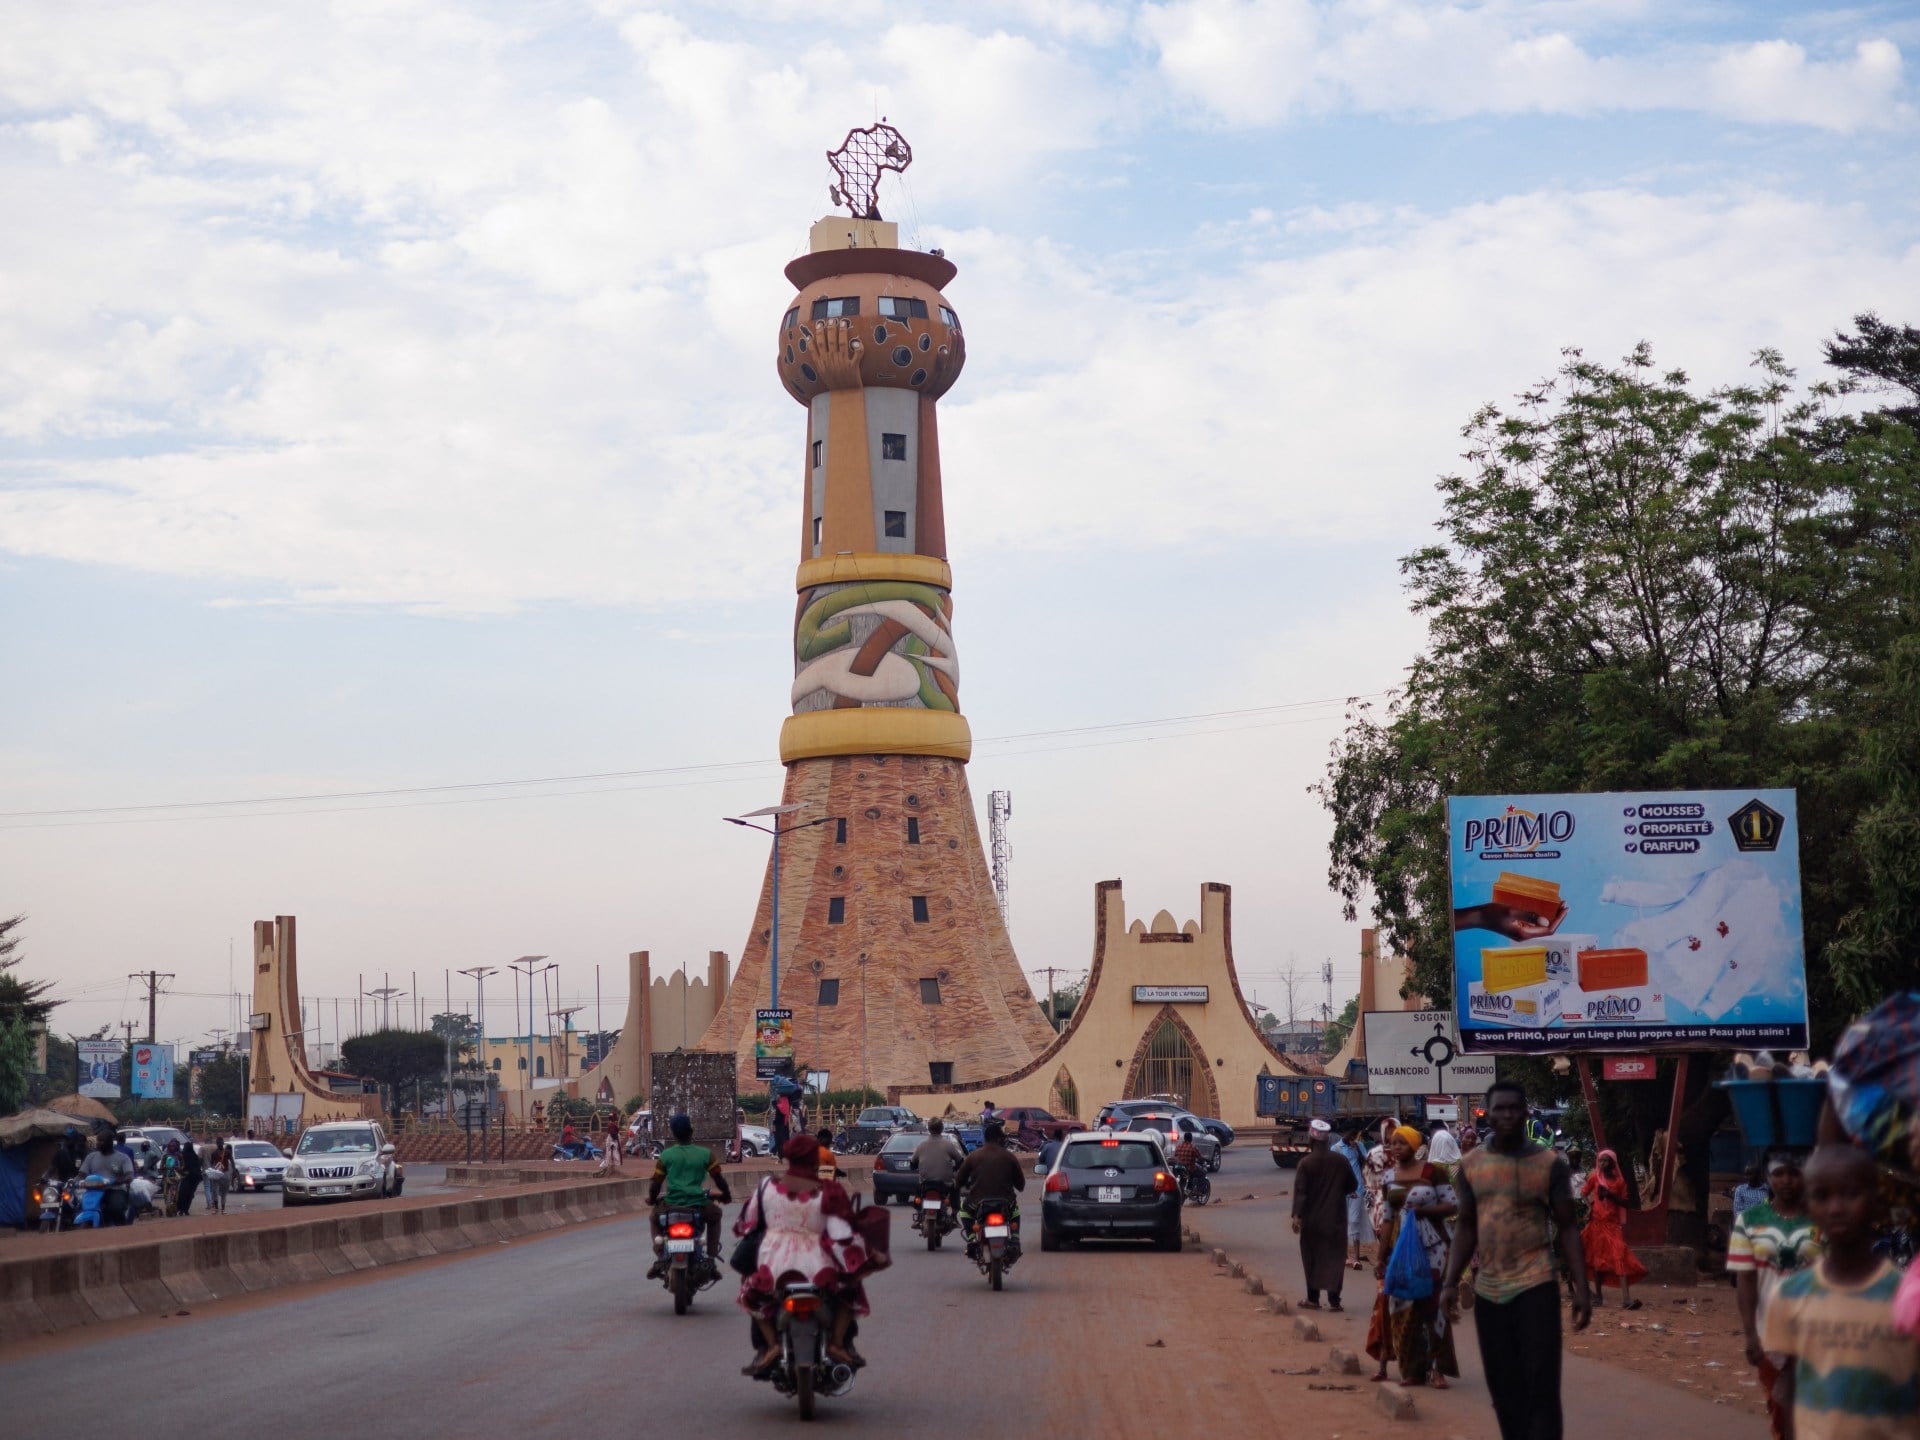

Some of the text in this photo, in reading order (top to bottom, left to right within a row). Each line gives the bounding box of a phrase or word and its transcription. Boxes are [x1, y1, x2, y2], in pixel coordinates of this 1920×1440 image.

[1642, 806, 1701, 816] MOUSSES
[1463, 810, 1575, 852] PRIMO
[1642, 820, 1709, 834] PROPRETÉ
[1643, 841, 1695, 851] PARFUM
[1470, 995, 1513, 1010] PRIMO
[1587, 997, 1642, 1018] PRIMO
[1413, 1013, 1450, 1021] SOGONI
[1475, 1032, 1504, 1041] Savon
[1507, 1031, 1545, 1041] PRIMO,
[1547, 1031, 1570, 1042] pour
[1573, 1031, 1586, 1039] un
[1588, 1030, 1614, 1040] Linge
[1617, 1030, 1637, 1040] plus
[1639, 1030, 1673, 1040] propre
[1675, 1029, 1686, 1037] et
[1688, 1029, 1707, 1037] une
[1709, 1028, 1733, 1037] Peau
[1736, 1027, 1756, 1038] plus
[1758, 1027, 1785, 1036] saine
[1369, 1066, 1495, 1075] KALABANCORO YIRIMADIO
